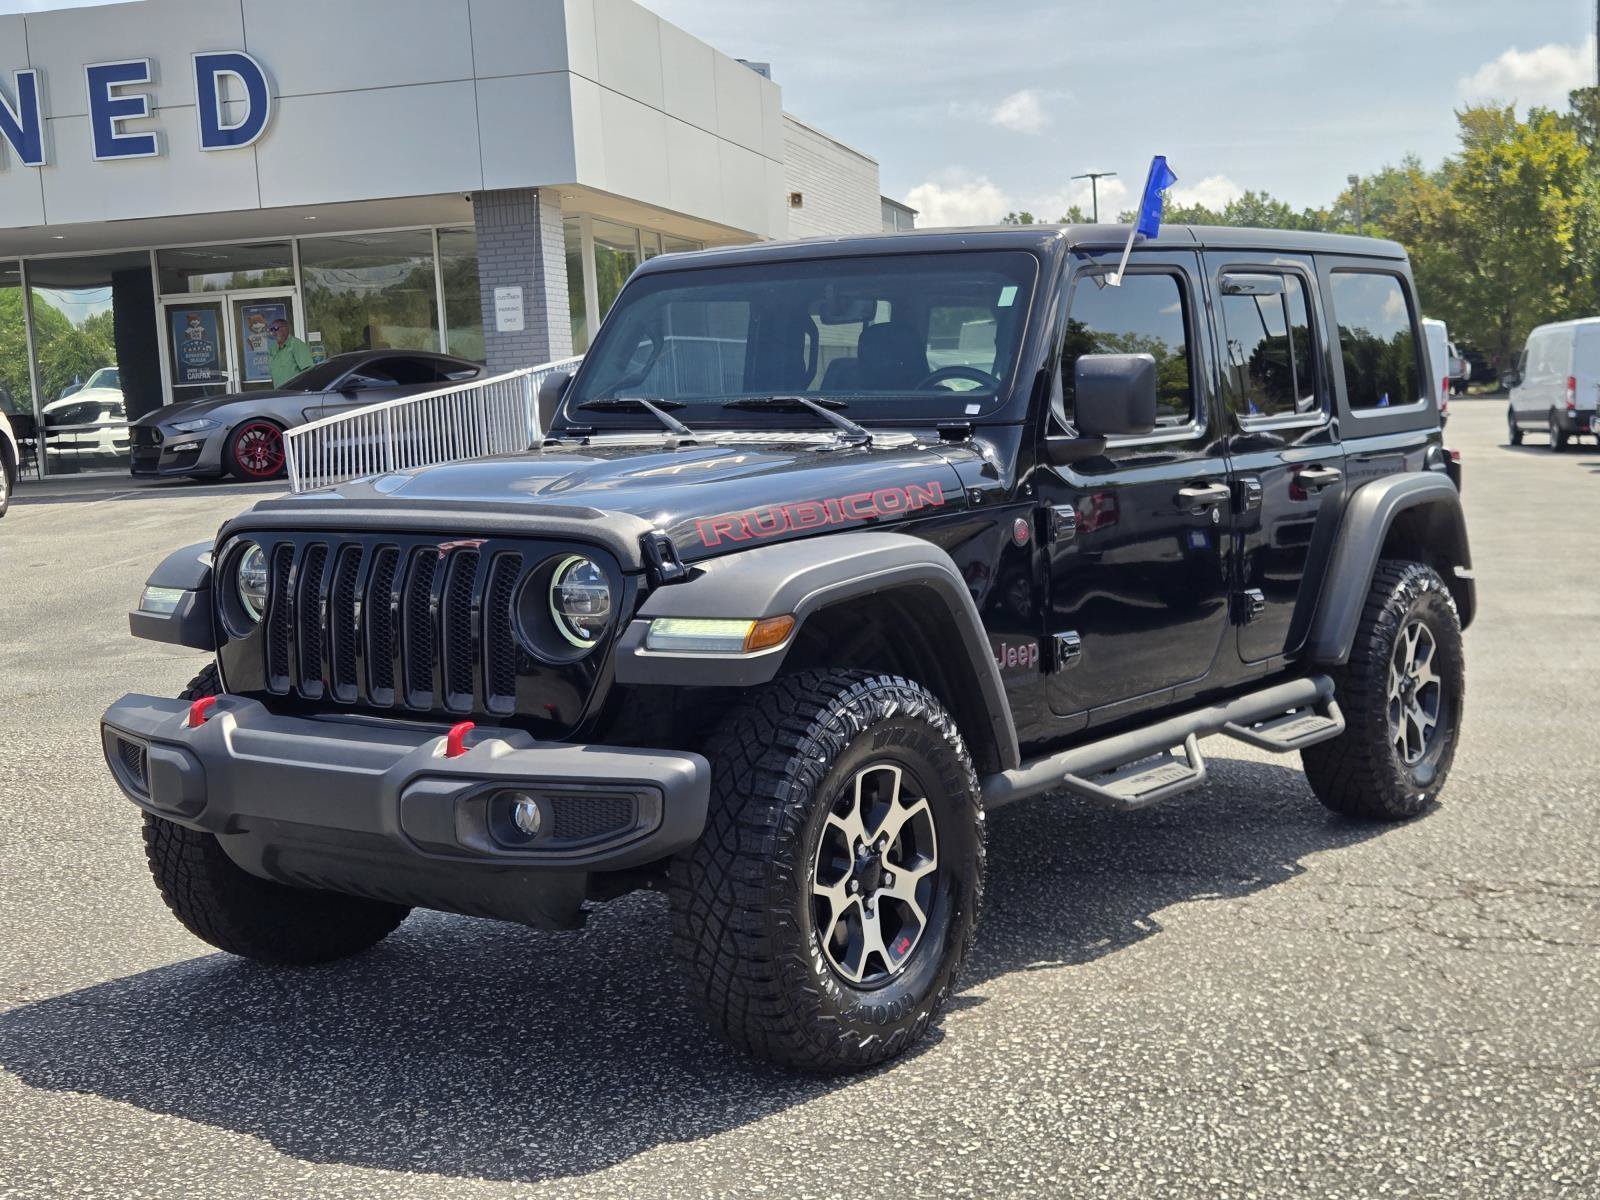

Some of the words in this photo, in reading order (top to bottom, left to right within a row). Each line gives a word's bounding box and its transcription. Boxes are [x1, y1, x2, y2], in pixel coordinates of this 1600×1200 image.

[187, 372, 211, 380] CARFAX
[696, 481, 945, 547] RUBICON
[995, 642, 1040, 670] Jeep
